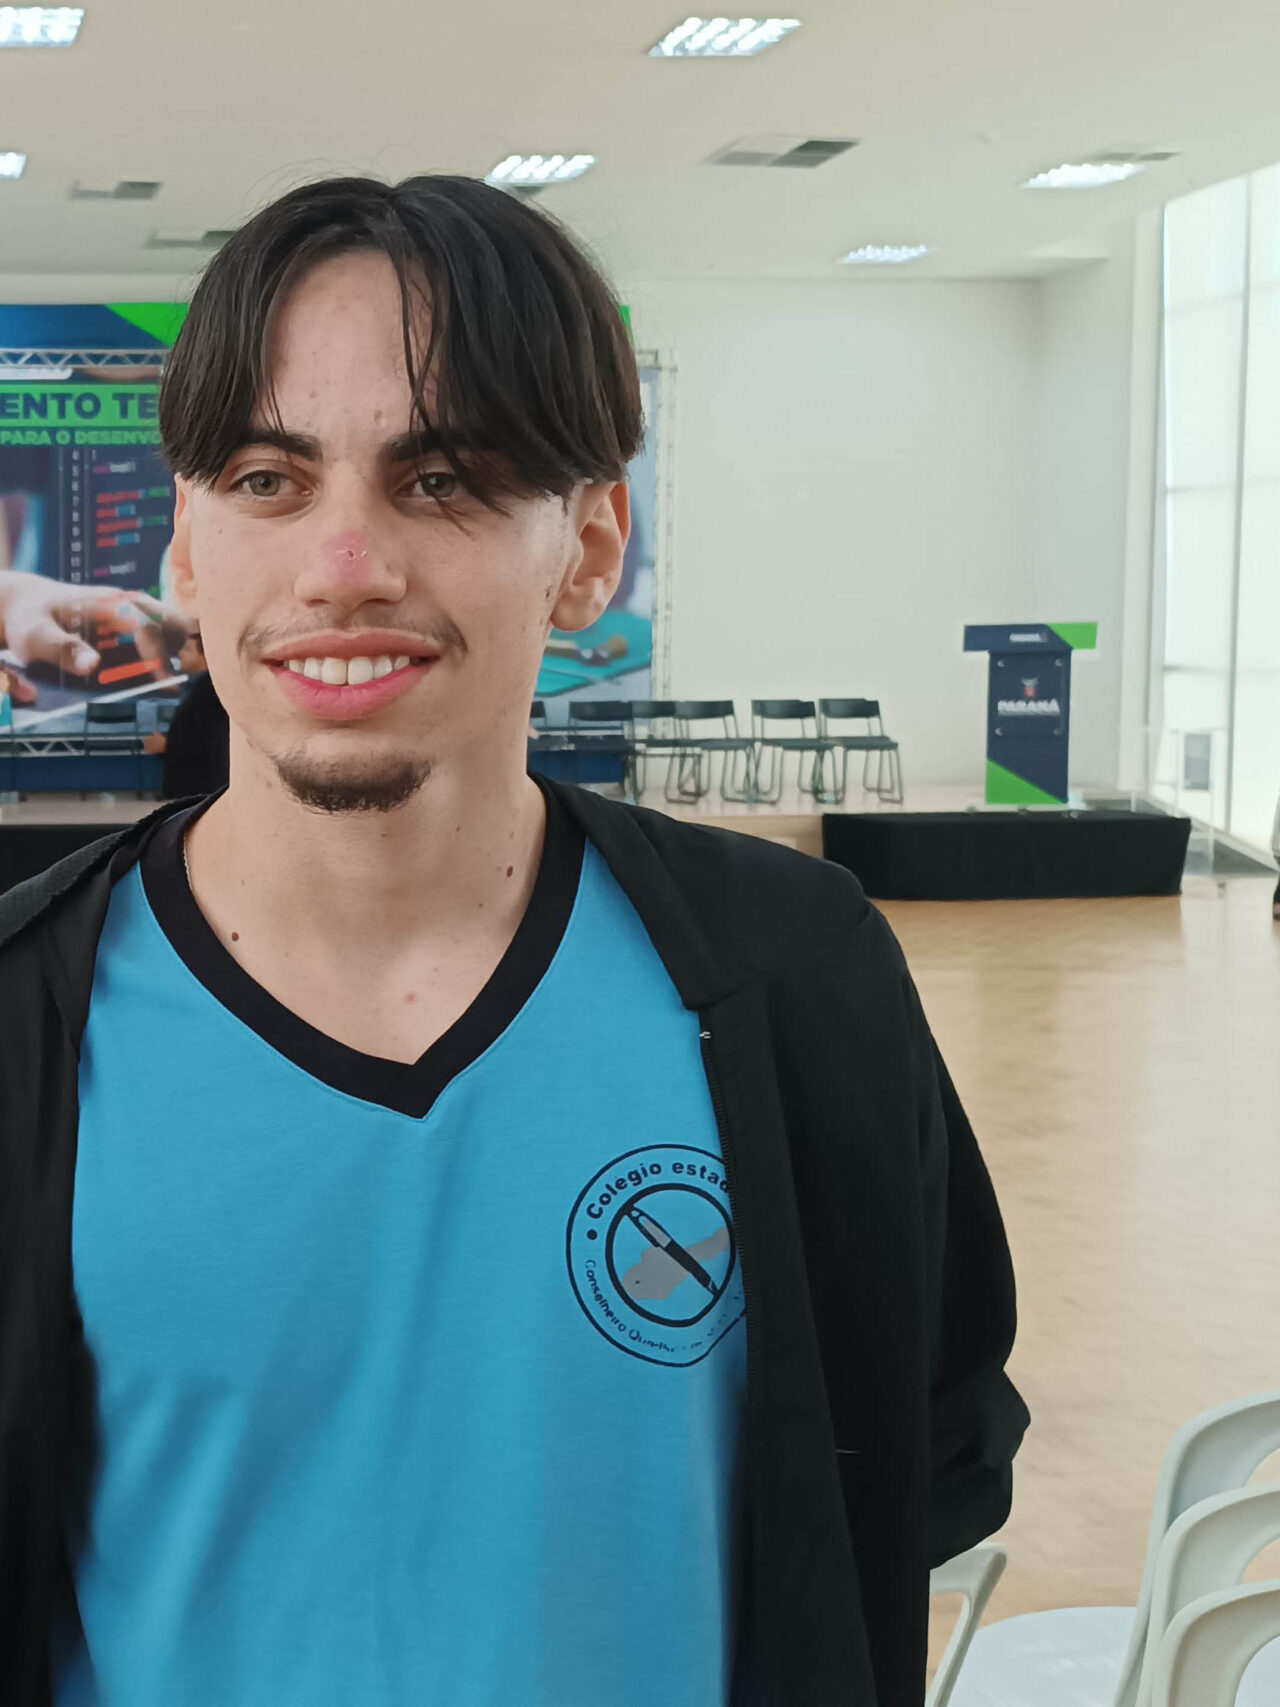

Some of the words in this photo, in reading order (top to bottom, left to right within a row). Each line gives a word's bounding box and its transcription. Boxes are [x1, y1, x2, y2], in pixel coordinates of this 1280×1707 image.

[0, 430, 52, 446] PARA
[55, 430, 70, 446] O
[586, 1163, 662, 1219] Colegio
